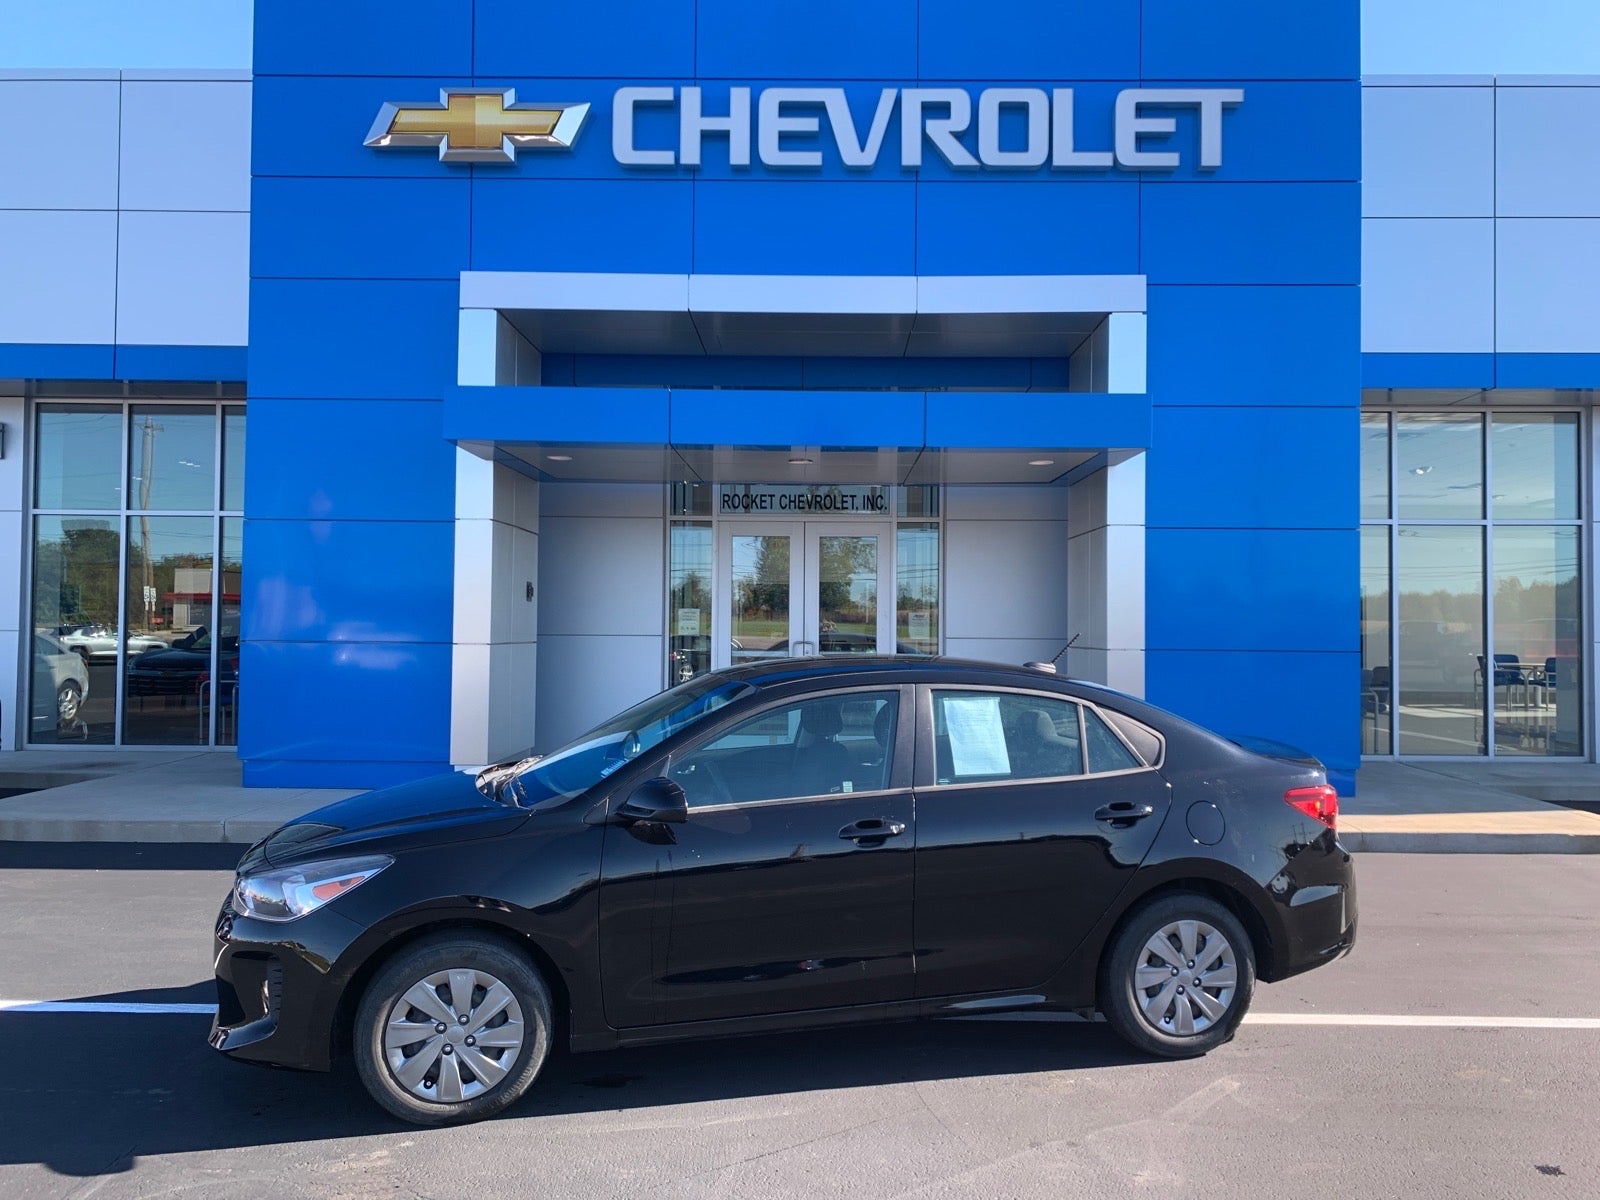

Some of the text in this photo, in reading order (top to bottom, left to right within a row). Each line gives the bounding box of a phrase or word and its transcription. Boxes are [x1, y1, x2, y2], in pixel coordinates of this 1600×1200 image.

[612, 86, 1246, 169] CHEVROLET
[721, 493, 888, 512] ROCKET CHEVROLET, INC.
